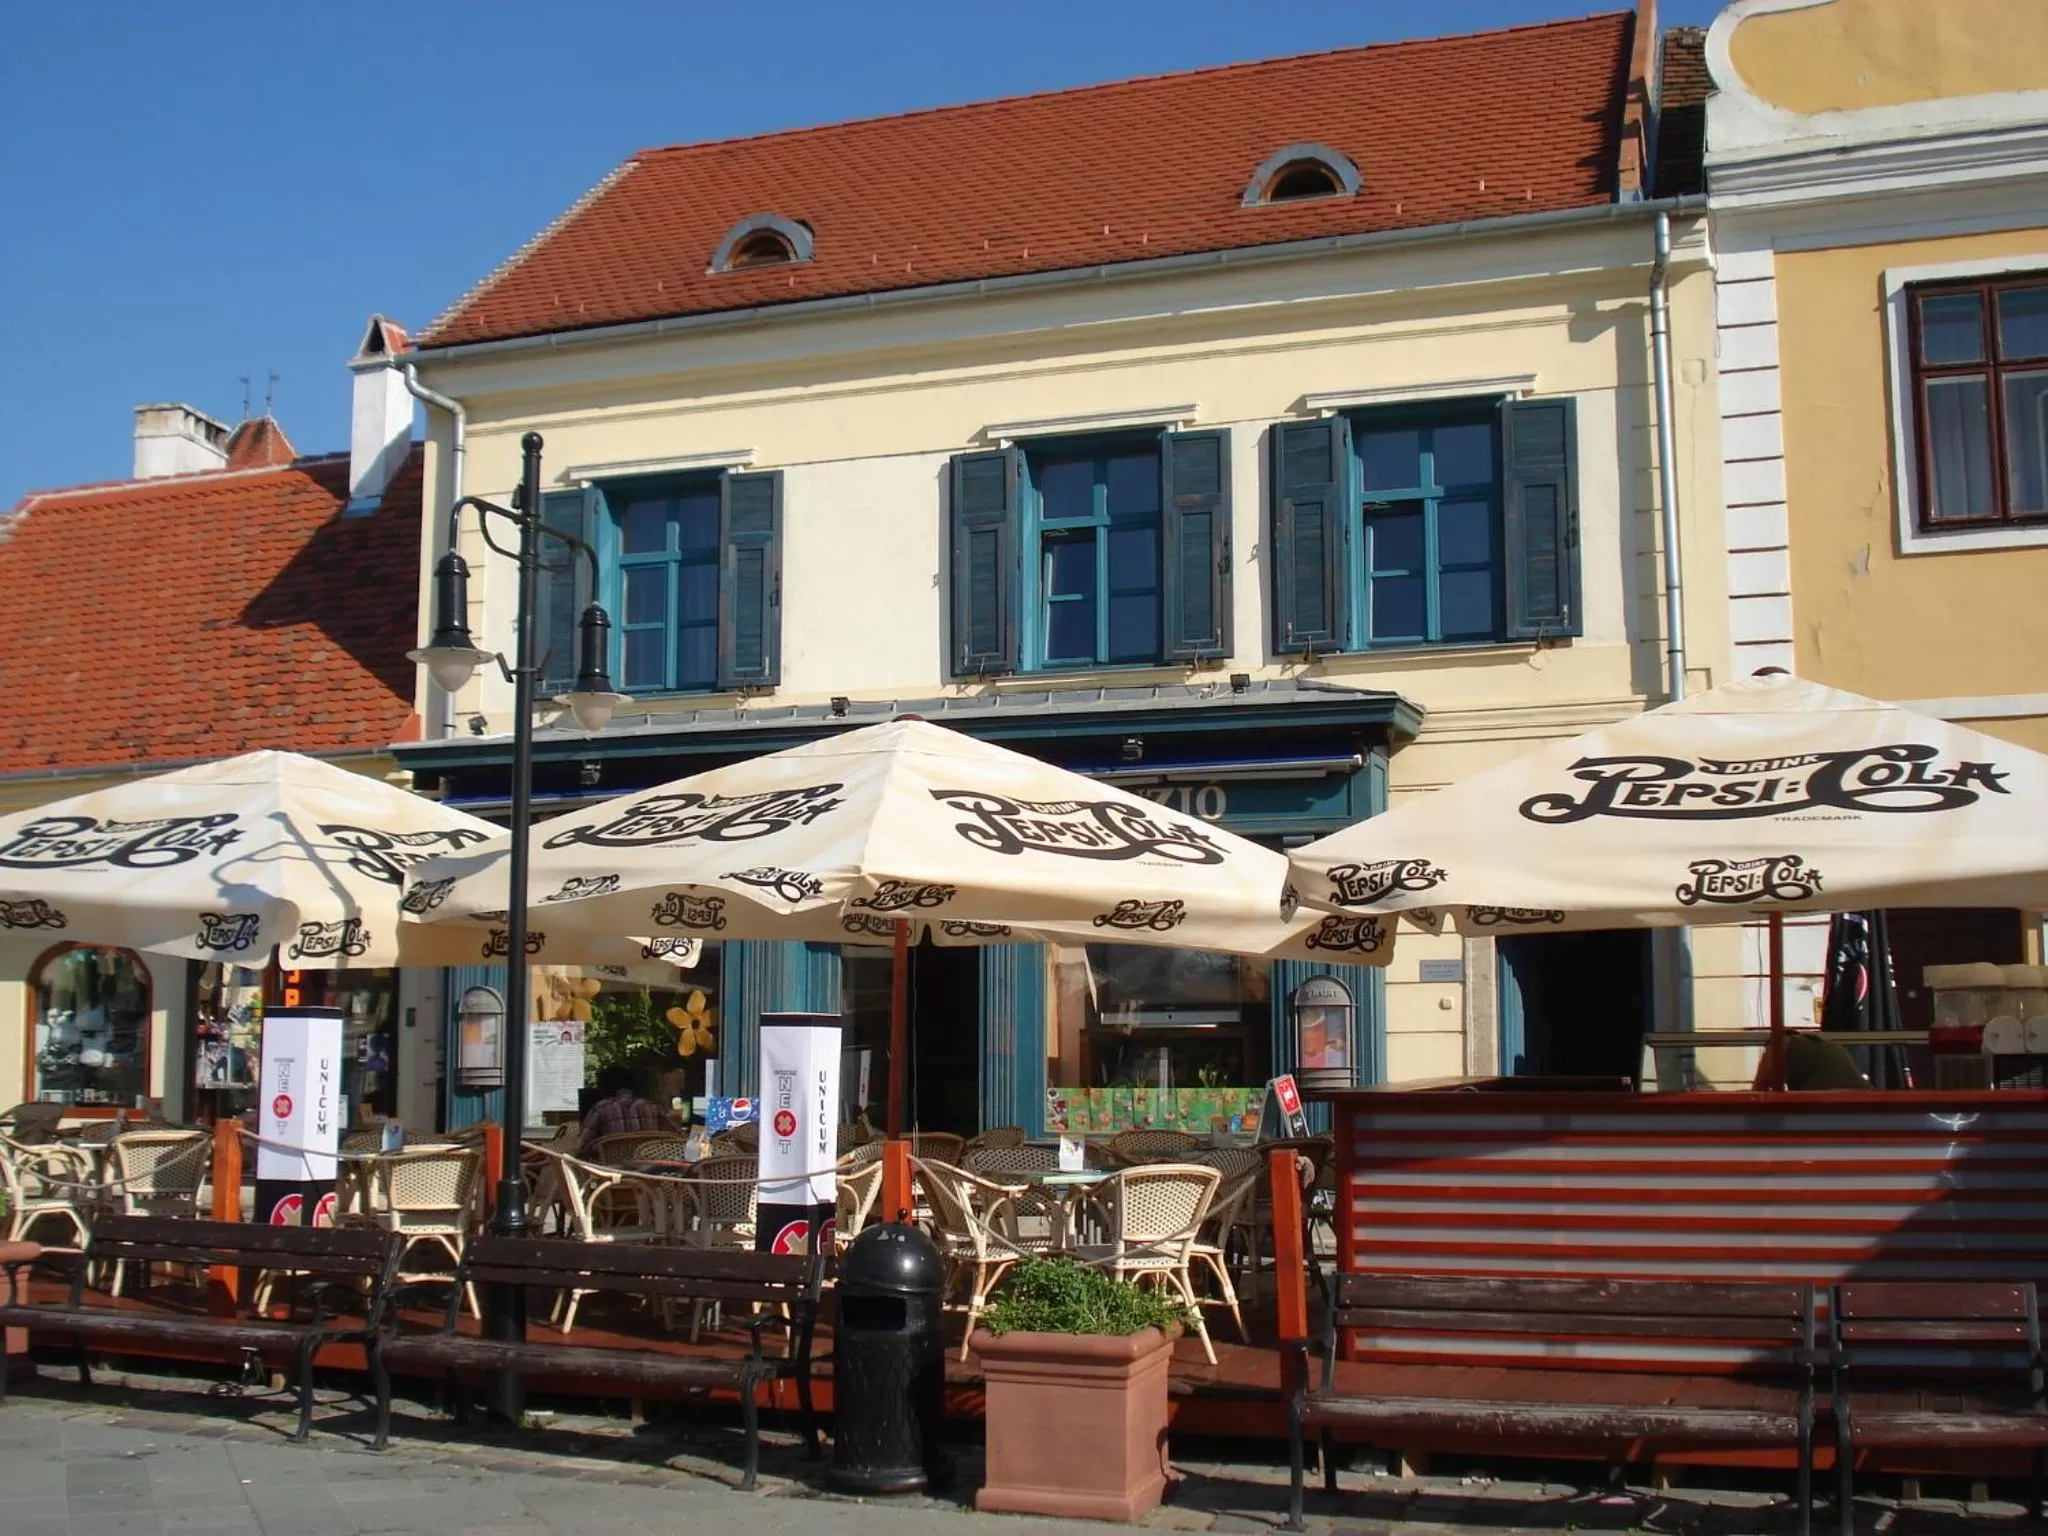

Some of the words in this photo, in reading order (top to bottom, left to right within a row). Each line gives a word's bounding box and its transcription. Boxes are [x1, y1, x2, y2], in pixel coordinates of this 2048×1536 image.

[1728, 755, 1821, 774] DRINK
[316, 1058, 329, 1135] UNICUM
[819, 1071, 828, 1154] UNICUM
